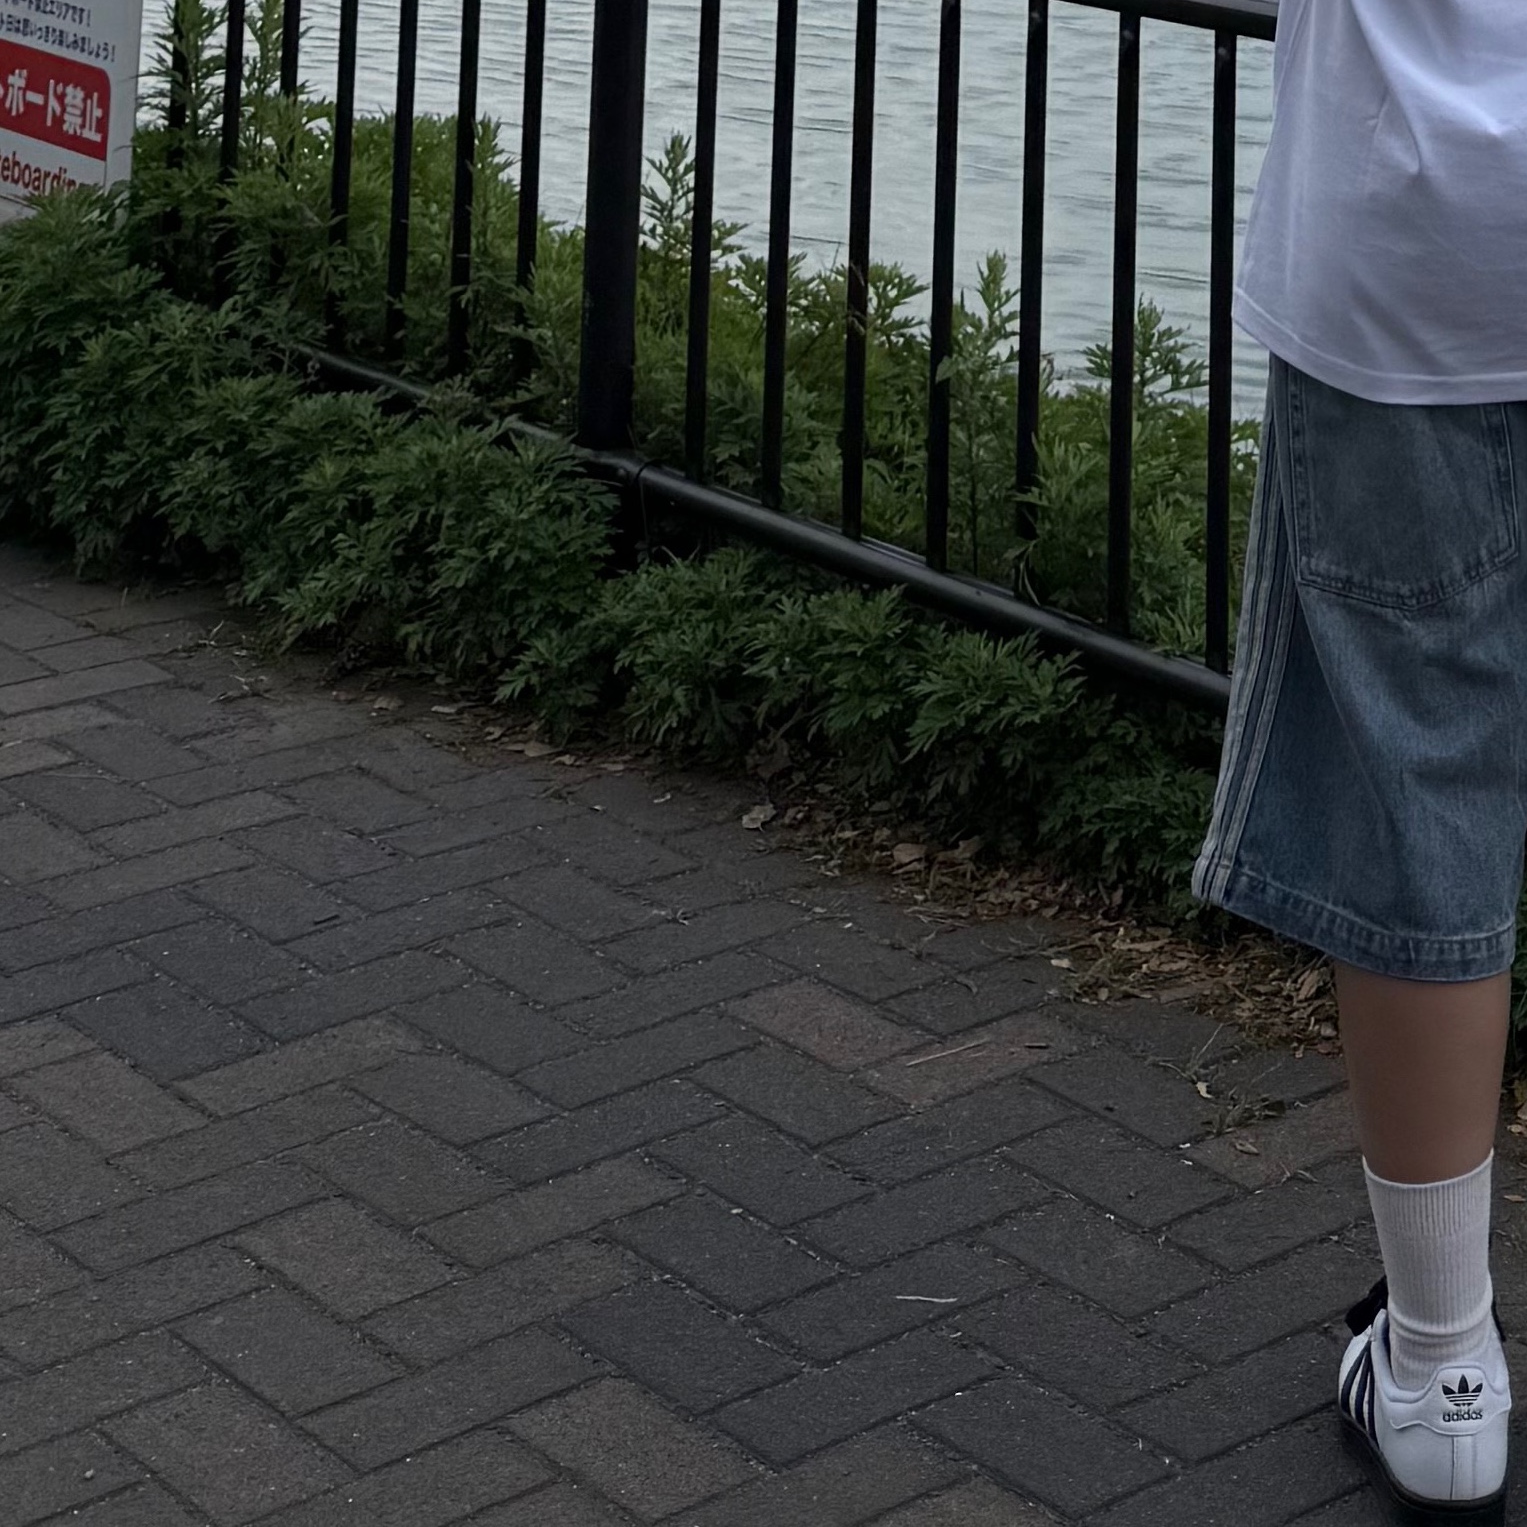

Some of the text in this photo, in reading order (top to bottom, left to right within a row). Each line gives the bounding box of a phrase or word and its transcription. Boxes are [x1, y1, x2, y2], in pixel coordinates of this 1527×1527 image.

[0, 68, 103, 143] ボード禁止
[1442, 1409, 1484, 1423] adidas
